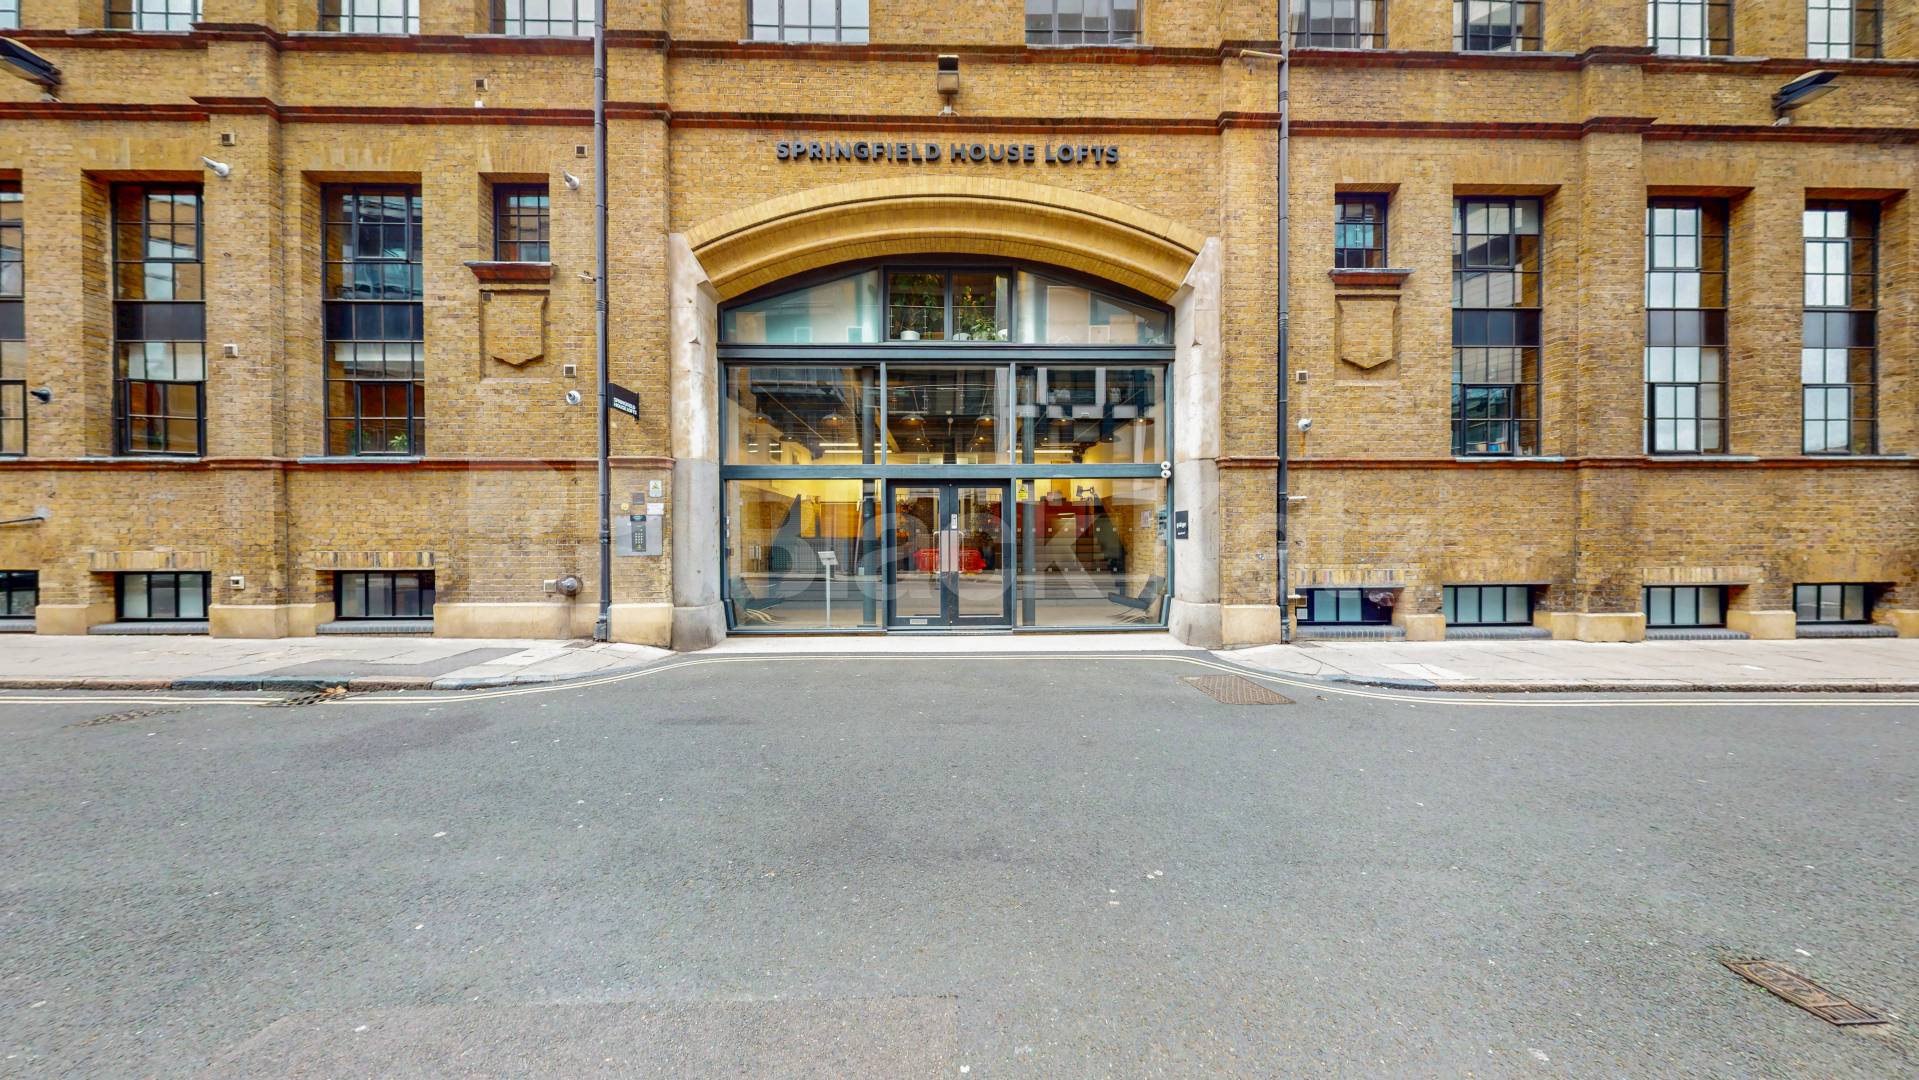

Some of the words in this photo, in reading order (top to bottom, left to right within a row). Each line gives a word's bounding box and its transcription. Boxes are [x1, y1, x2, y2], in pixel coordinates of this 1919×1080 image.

[776, 141, 942, 161] SPRINGFIELD
[950, 143, 1035, 162] HOUSE
[1045, 144, 1119, 164] LOFTS
